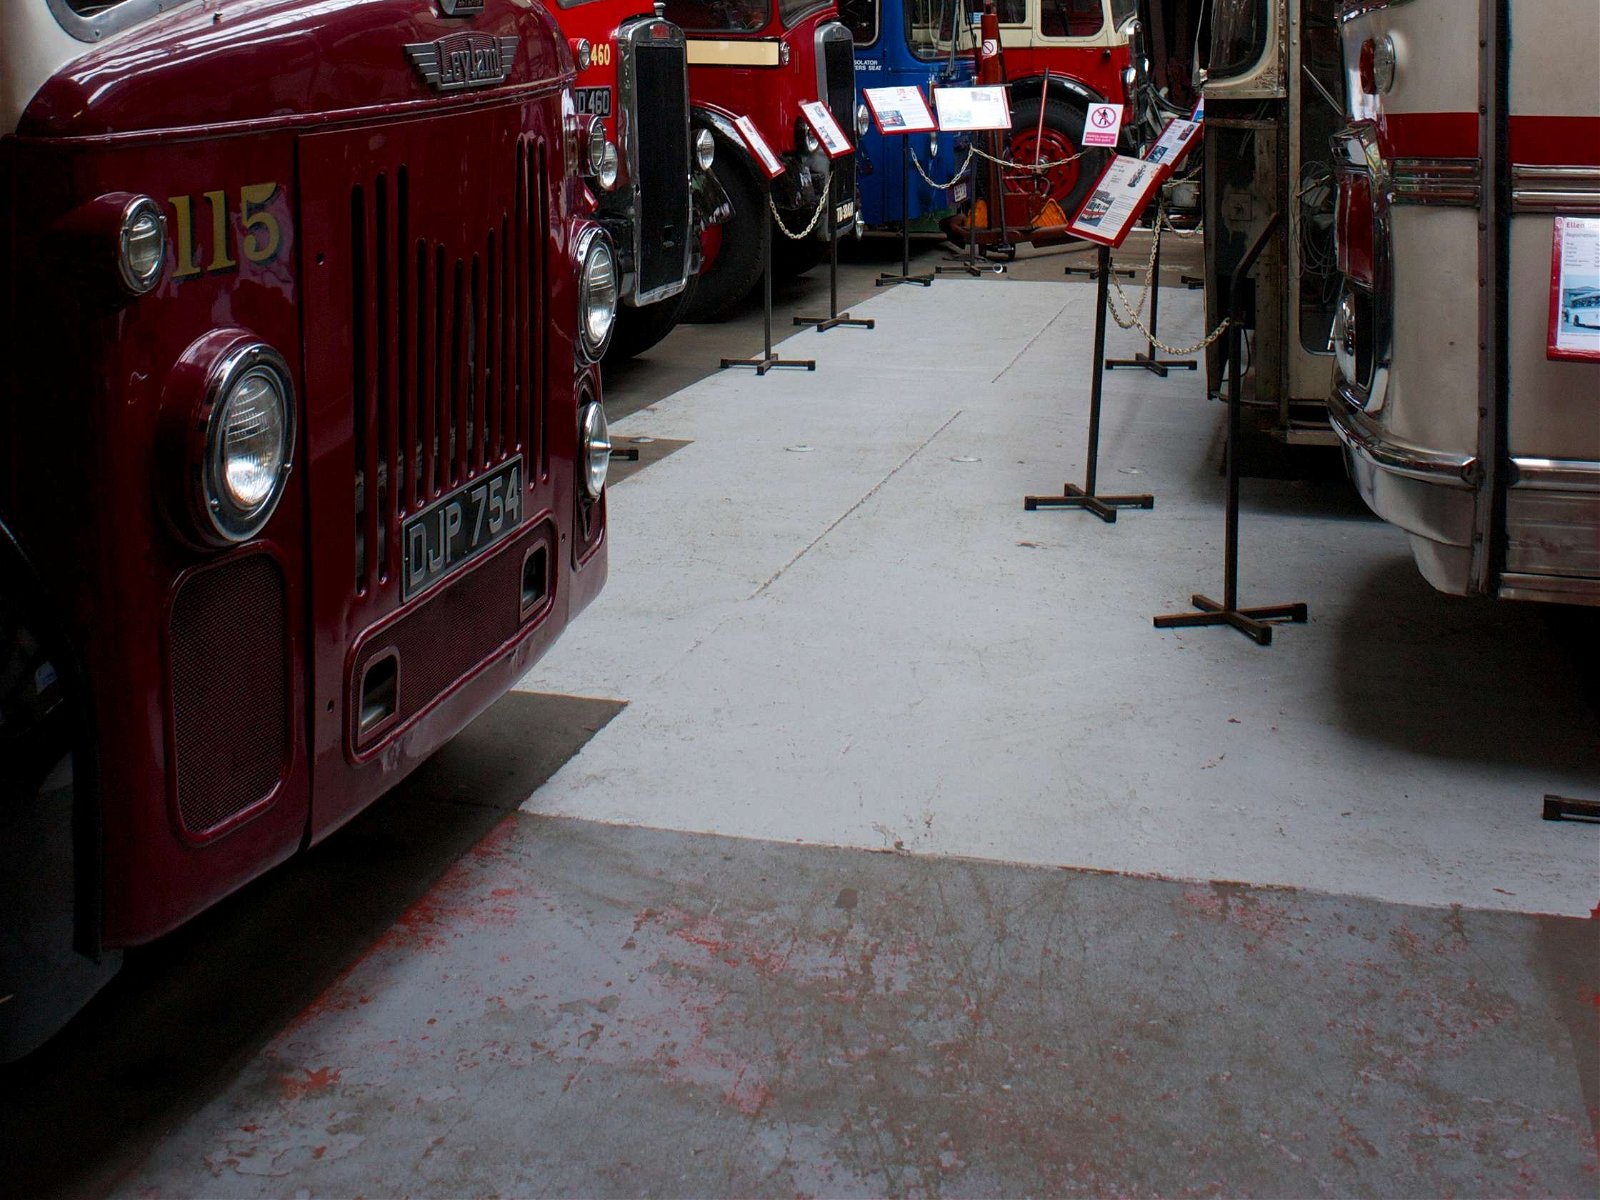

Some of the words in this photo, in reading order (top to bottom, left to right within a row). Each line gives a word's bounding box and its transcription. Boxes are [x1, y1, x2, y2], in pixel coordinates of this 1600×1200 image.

[438, 37, 502, 88] Leyland
[590, 43, 611, 67] 460
[575, 91, 586, 114] D
[588, 90, 610, 115] 460
[168, 182, 281, 280] 115
[409, 502, 462, 587] DJP
[470, 466, 520, 548] 754
